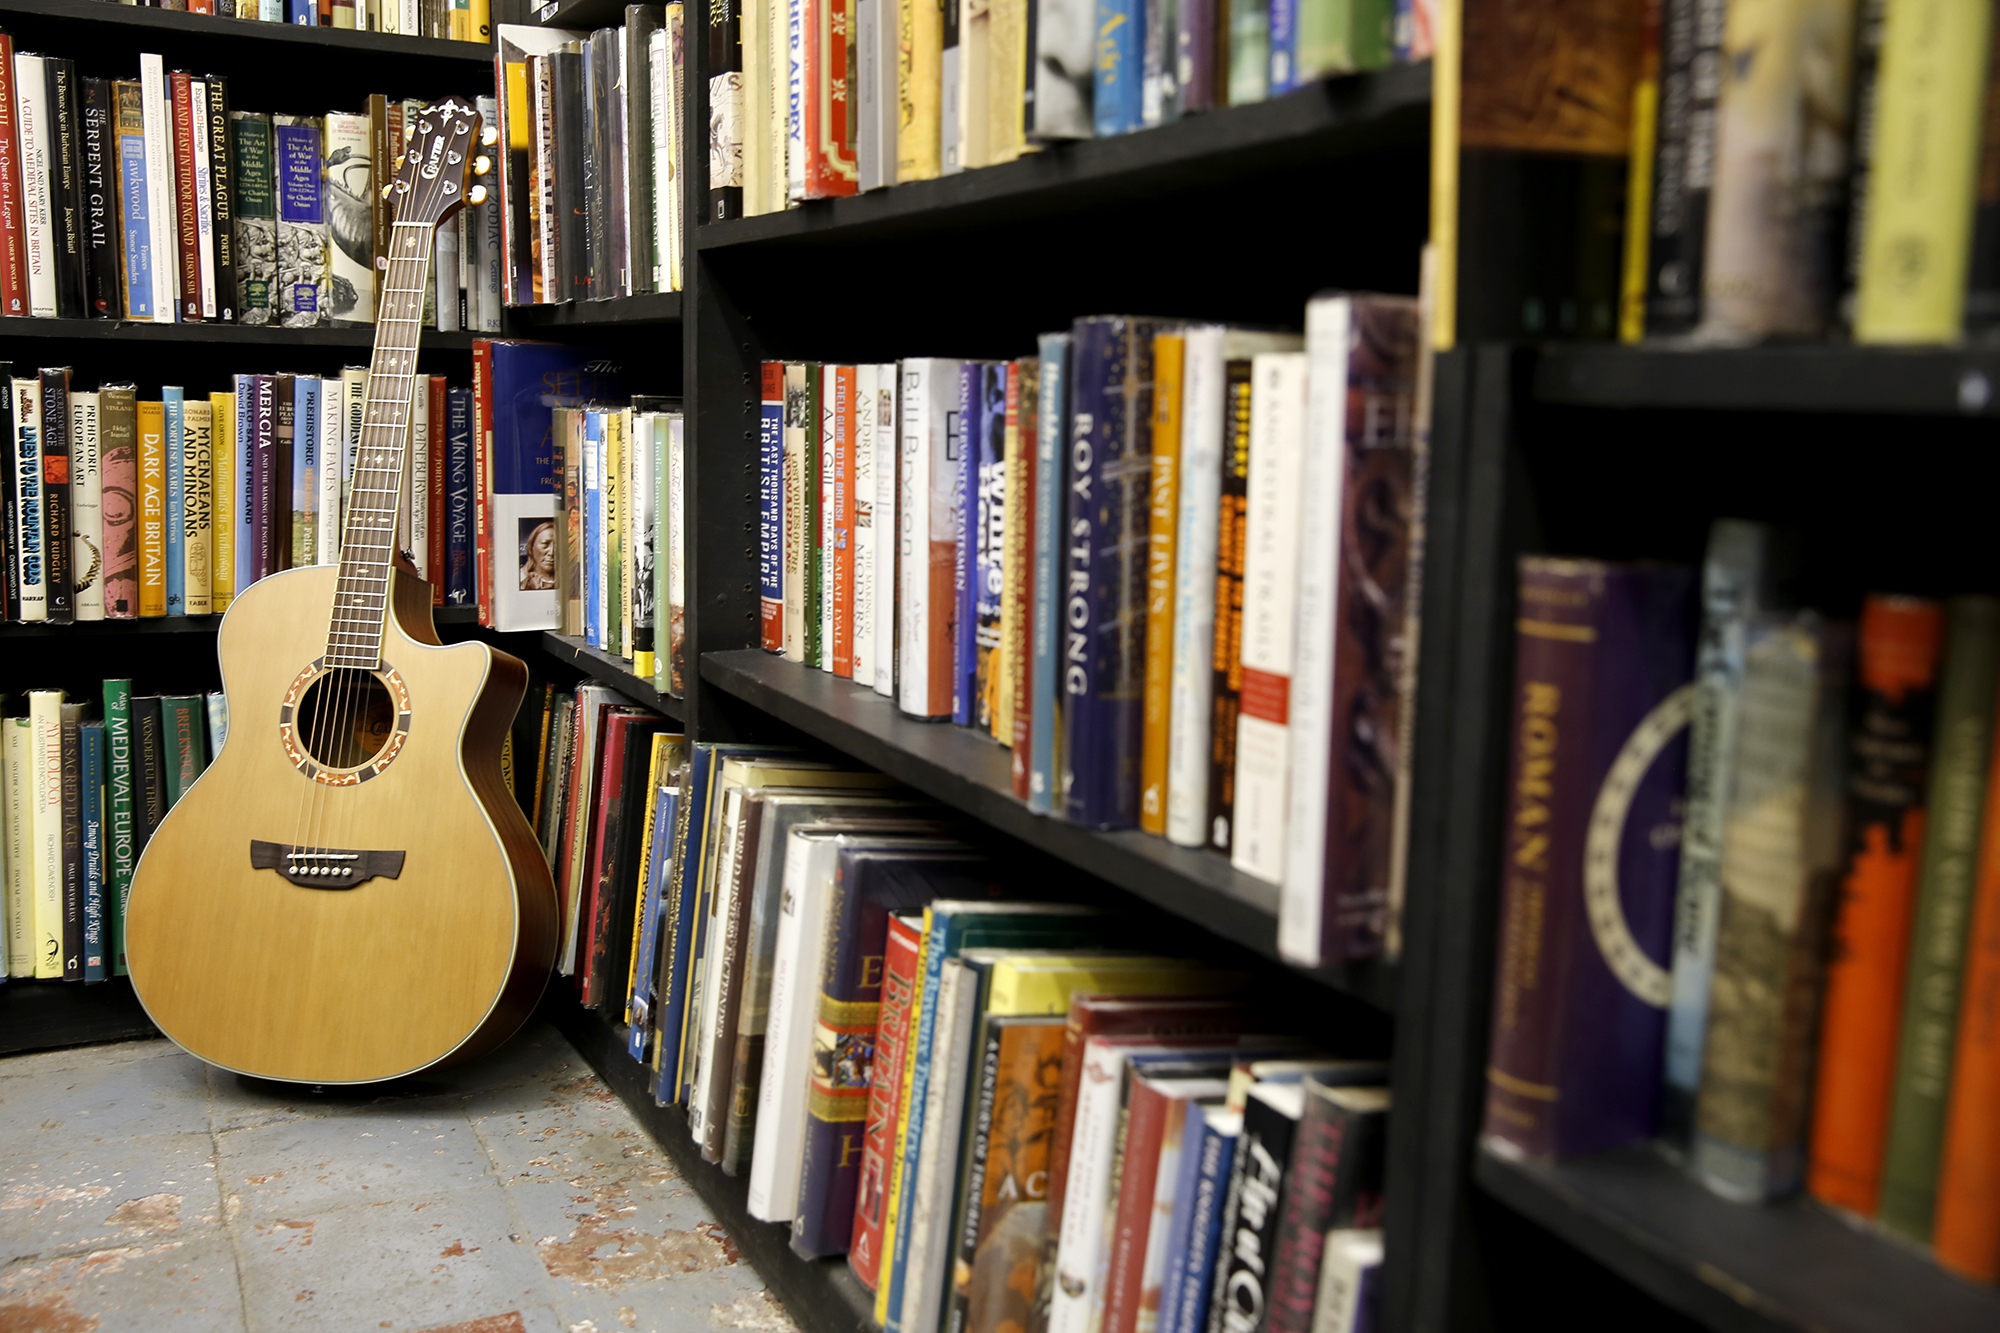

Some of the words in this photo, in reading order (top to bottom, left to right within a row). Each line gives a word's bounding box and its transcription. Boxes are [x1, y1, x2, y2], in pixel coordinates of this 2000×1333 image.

[57, 70, 65, 83] The
[58, 85, 66, 107] Bronze
[176, 77, 189, 103] FOOD
[58, 109, 66, 123] Age
[177, 104, 190, 125] AND
[211, 82, 223, 112] THE
[23, 106, 32, 135] GUIDE
[178, 127, 191, 153] FEAST
[212, 115, 225, 161] GREAT
[25, 137, 33, 150] TO
[60, 132, 70, 164] Barbarian
[86, 108, 102, 188] SERPENT
[180, 154, 191, 165] IN
[421, 135, 445, 179] CRAFTER
[0, 157, 11, 179] Quest
[2, 182, 12, 192] for
[26, 152, 36, 198] MEDIEVAL
[62, 166, 71, 190] Europe
[180, 167, 192, 200] TUDOR
[215, 165, 228, 220] PLAGUE
[3, 201, 15, 229] Legend
[29, 200, 38, 225] SITES
[31, 226, 39, 237] IN
[90, 194, 105, 249] GRAIL
[182, 201, 194, 246] ENGLAND
[488, 195, 499, 249] ZODIAC
[32, 239, 41, 275] BRITAIN
[221, 234, 230, 266] PORTER
[490, 259, 499, 294] Gettings
[45, 388, 56, 423] STONE
[169, 400, 178, 419] THE
[351, 381, 363, 400] THE
[836, 385, 845, 413] FIELD
[903, 371, 919, 422] Bill
[259, 379, 273, 449] MERCIA
[306, 391, 315, 465] PREHISTORIC
[327, 390, 337, 446] MAKING
[350, 402, 363, 444] GODDESS
[452, 397, 466, 428] THE
[836, 416, 845, 444] GUIDE
[1038, 361, 1058, 460] Heraldry
[19, 426, 37, 457] LINES
[46, 424, 57, 447] AGE
[74, 404, 84, 463] EUROPEAN
[86, 405, 97, 476] PREHISTORIC
[170, 421, 178, 448] NORTH
[185, 426, 197, 460] AND
[475, 401, 483, 460] AMERICAN
[862, 394, 871, 479] ANDREW
[21, 458, 37, 474] TO
[143, 433, 160, 479] DARK
[170, 450, 178, 465] SEA
[325, 452, 336, 491] FACES
[415, 423, 427, 494] DANEBURY
[451, 431, 468, 483] VIKING
[654, 440, 662, 471] India
[761, 417, 770, 500] BRITISH
[791, 452, 799, 483] LOST
[836, 447, 844, 460] TO
[836, 462, 844, 480] THE
[957, 418, 969, 491] SERVANTS
[1070, 412, 1094, 499] ROY
[21, 475, 37, 497] THE
[75, 467, 85, 487] ART
[170, 466, 179, 497] EARLS
[198, 426, 211, 530] MYCENAEANS
[304, 467, 313, 523] HERITAGE
[770, 469, 778, 520] THOUSAND
[902, 435, 918, 556] Bryson
[50, 493, 59, 537] RICHARD
[145, 483, 161, 516] AGE
[185, 465, 197, 538] MINOANS
[451, 486, 468, 543] VOYAGE
[607, 475, 616, 536] INDIA
[654, 475, 662, 554] Remembered
[792, 487, 800, 528] VOICES
[835, 482, 844, 521] BRITISH
[957, 495, 967, 505] &
[21, 499, 40, 554] MOUNTAIN
[261, 515, 268, 524] OF
[303, 527, 312, 551] Felix
[770, 526, 778, 549] DAYS
[793, 531, 800, 546] OF
[987, 460, 1007, 596] White
[51, 541, 61, 584] RUDGLEY
[145, 521, 161, 586] BRITAIN
[761, 514, 770, 586] EMPIRE
[770, 555, 777, 567] OF
[791, 549, 799, 574] THE
[955, 508, 966, 591] STATESMEN
[23, 555, 41, 585] GODS
[834, 555, 843, 602] SARAH
[854, 543, 864, 639] MODERN
[1065, 519, 1091, 698] STRONG
[834, 609, 842, 647] LYALL
[865, 620, 871, 635] OF
[63, 718, 77, 745] THE
[141, 715, 155, 784] WONDERFUL
[176, 708, 193, 781] BRECKNOCK
[570, 703, 582, 767] WASHINGTON
[46, 721, 62, 808] MYTHOLOGY
[64, 748, 79, 802] SACRED
[111, 717, 131, 808] MEDIEVAL
[1515, 683, 1560, 868] ROMAN
[144, 786, 156, 825] THINGS
[681, 784, 694, 840] DENNIS
[65, 806, 80, 849] PLACE
[84, 819, 99, 849] Among
[114, 811, 132, 878] EUROPE
[86, 851, 100, 879] Druids
[88, 881, 99, 896] and
[670, 844, 688, 926] FLANDERS'
[85, 898, 101, 918] High
[85, 920, 101, 945] Kings
[927, 927, 946, 973] The
[664, 929, 678, 1005] BRITANNIA
[915, 980, 941, 1059] Bayeux
[867, 964, 915, 1153] BRITAIN
[904, 1061, 931, 1160] Tapestry
